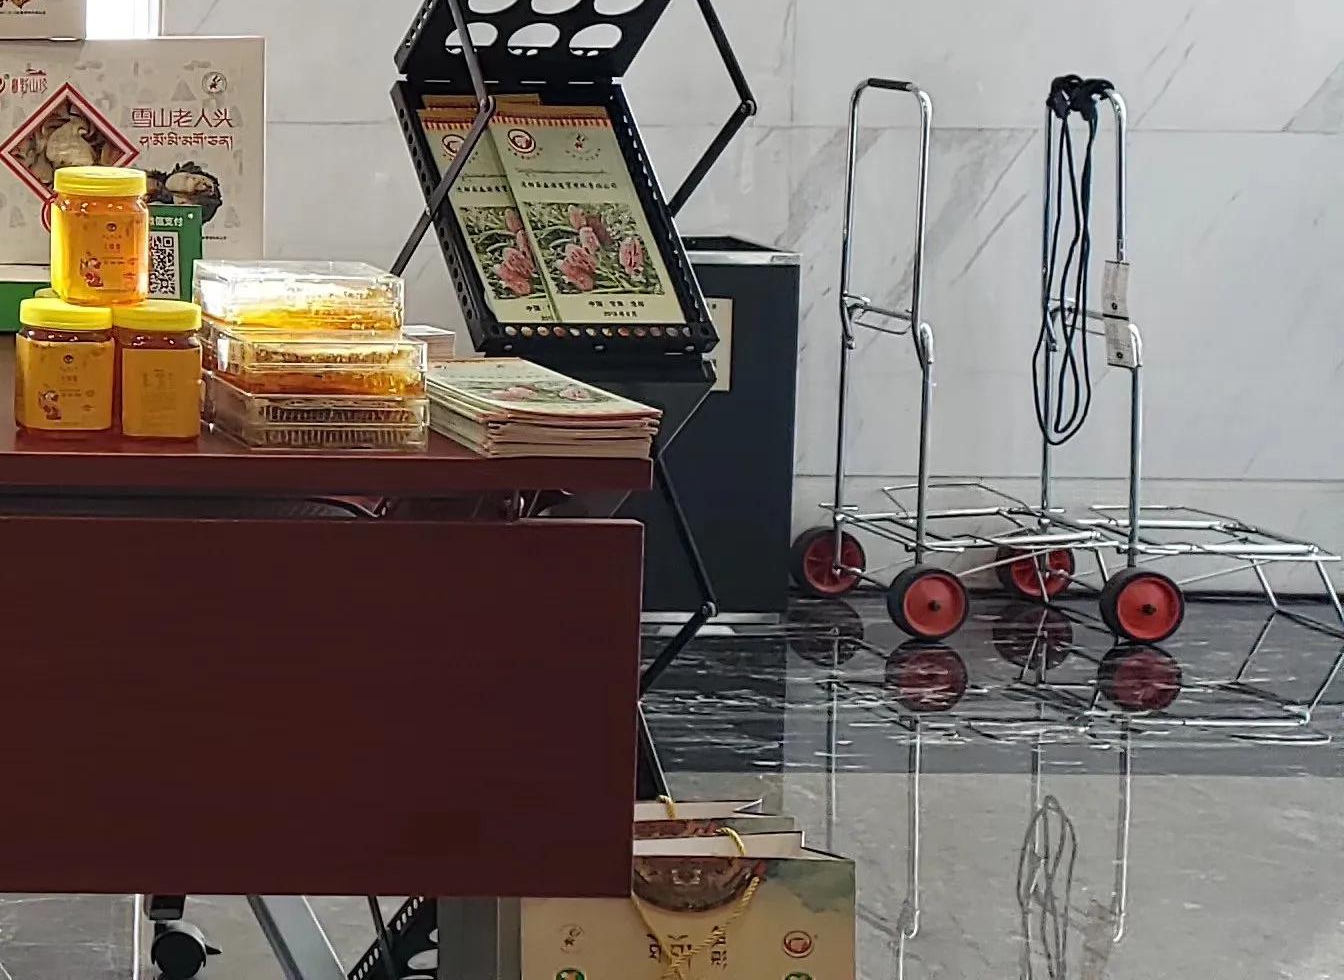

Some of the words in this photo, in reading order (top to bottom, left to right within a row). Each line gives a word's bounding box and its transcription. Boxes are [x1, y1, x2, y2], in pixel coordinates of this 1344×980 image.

[131, 107, 234, 128] 雪山老人头
